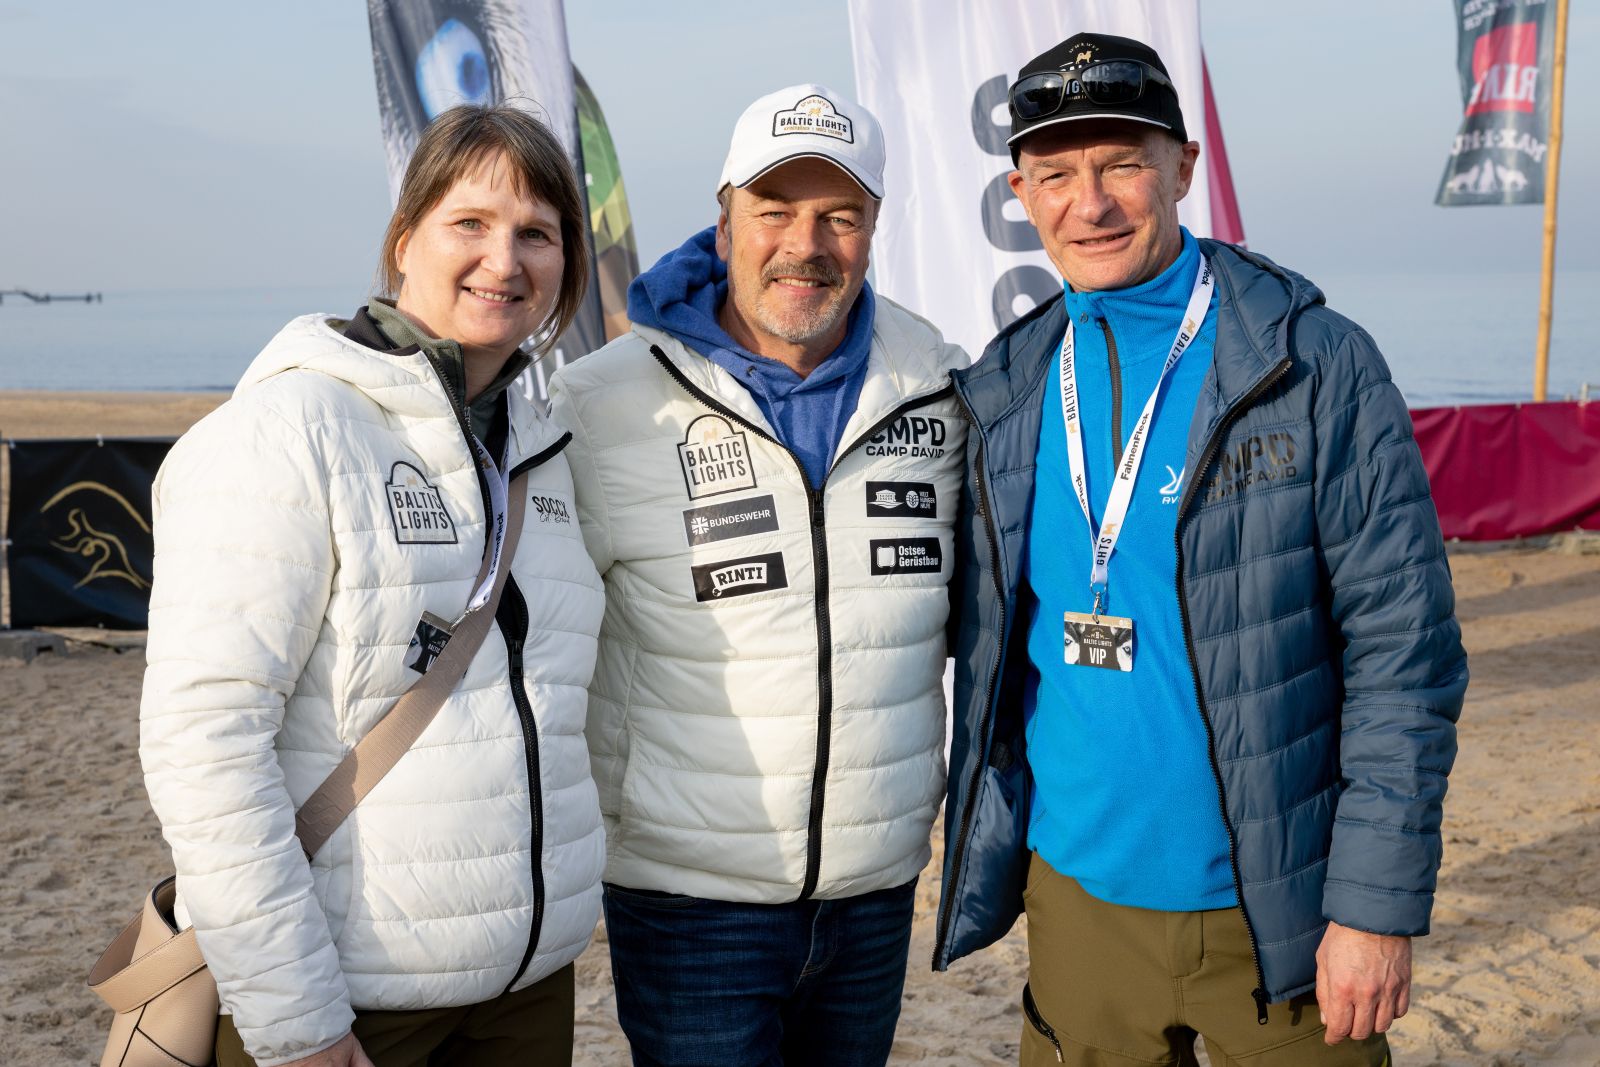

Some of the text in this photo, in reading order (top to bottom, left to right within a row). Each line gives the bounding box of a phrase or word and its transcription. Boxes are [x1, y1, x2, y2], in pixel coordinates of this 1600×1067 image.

[780, 117, 813, 126] BALTIC
[816, 119, 847, 133] LIGHTS
[1063, 344, 1076, 421] BALTIC LIGHTS
[686, 441, 742, 467] BALTIC
[866, 445, 945, 458] CAMP DAVID
[1120, 413, 1149, 481] FahnenFleck
[690, 459, 746, 486] LIGHTS
[393, 491, 441, 510] BALTIC
[532, 495, 570, 519] SOCCX
[398, 511, 448, 529] LIGHTS
[709, 509, 771, 528] BUNDESWEHR
[898, 545, 926, 556] Ostsee
[898, 555, 939, 567] Gerüstbau
[716, 566, 763, 587] RINTI
[1089, 646, 1107, 665] VIP
